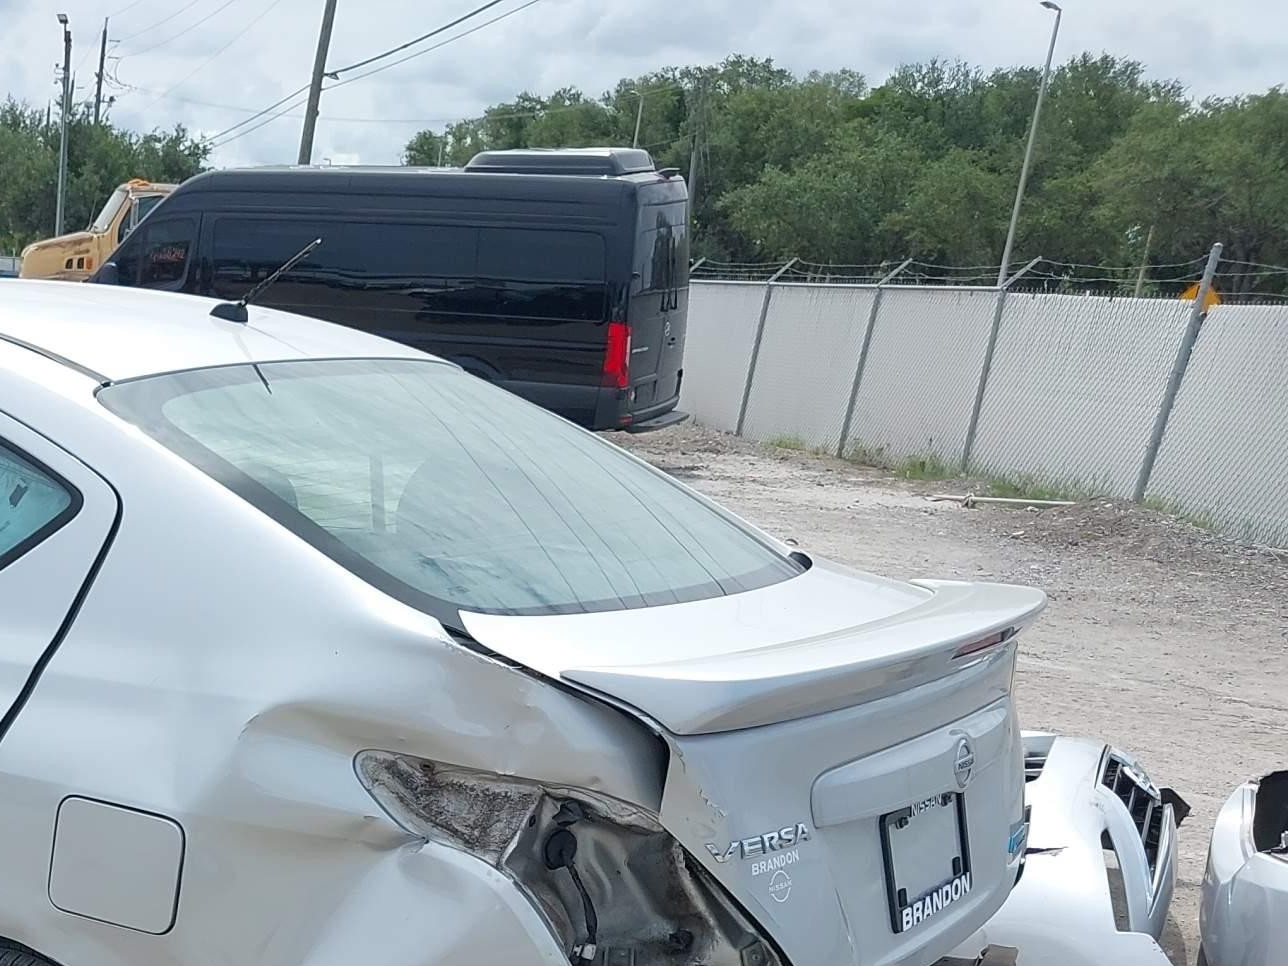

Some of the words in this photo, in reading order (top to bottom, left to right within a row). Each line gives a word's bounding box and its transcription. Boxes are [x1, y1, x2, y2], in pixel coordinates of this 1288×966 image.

[911, 793, 943, 817] NISSAN
[705, 823, 809, 863] VERSA
[752, 849, 800, 876] BRANDON
[768, 880, 792, 893] NISSAN
[902, 872, 971, 932] BRANDON
